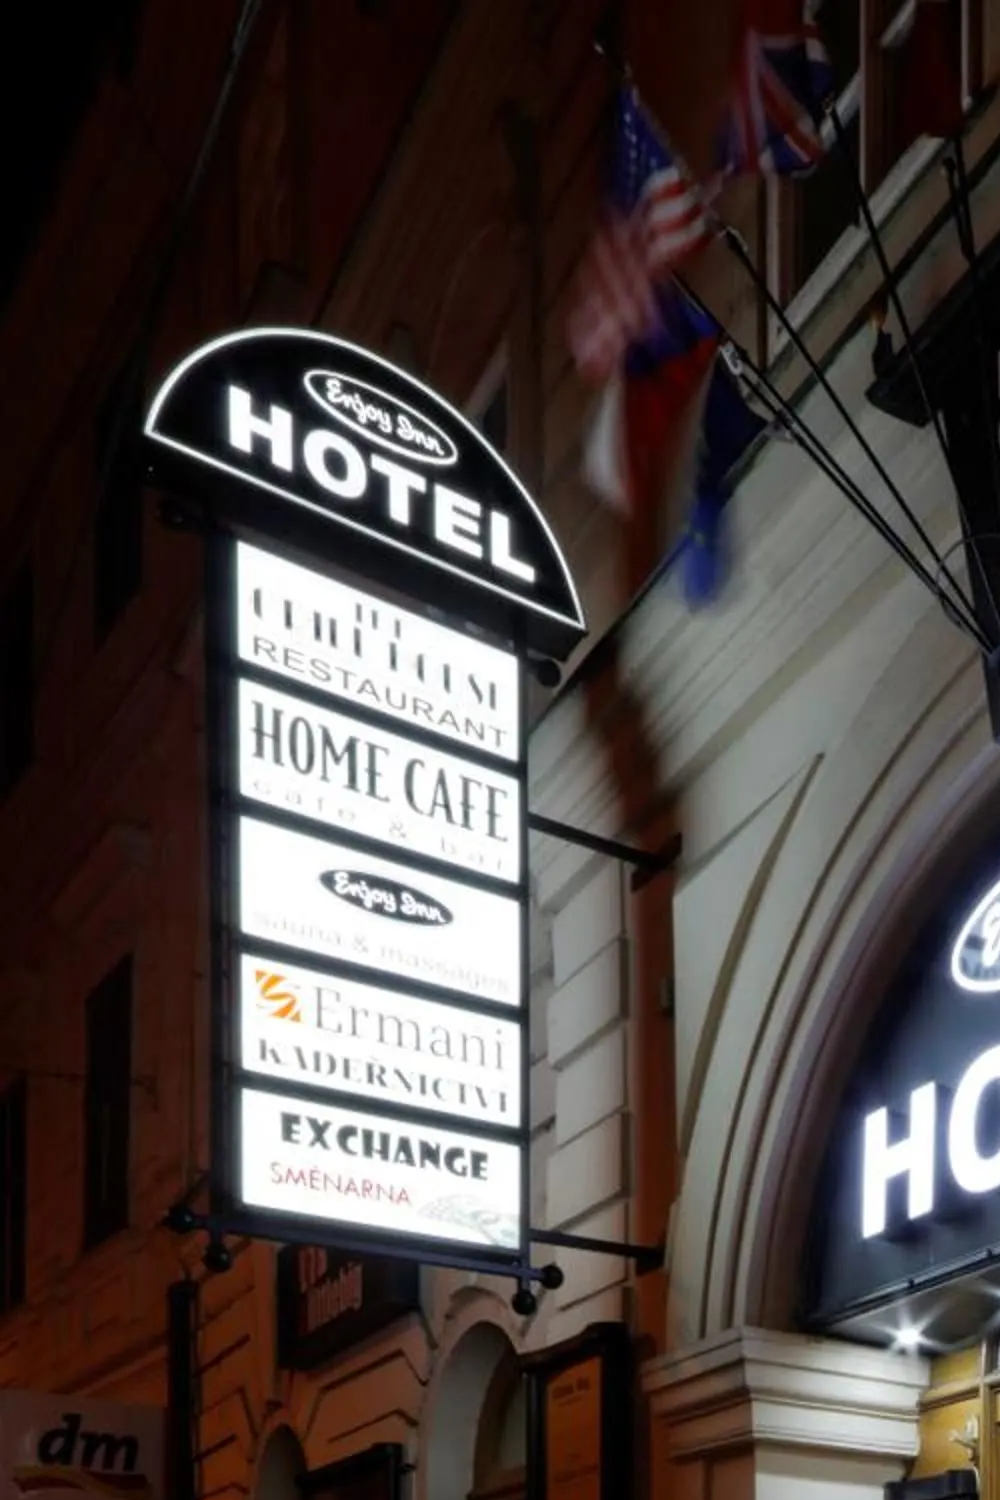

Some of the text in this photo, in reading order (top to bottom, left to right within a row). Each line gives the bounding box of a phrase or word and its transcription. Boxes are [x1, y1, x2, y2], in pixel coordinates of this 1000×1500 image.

[325, 378, 446, 456] Enjoy Inn
[228, 384, 536, 584] HOTEL
[253, 636, 508, 749] RESTAURANT
[249, 699, 510, 843] HOME CAFE
[333, 872, 447, 924] Enjoy Inn
[312, 984, 507, 1072] Ermani
[279, 1111, 490, 1182] EXCHANGE
[38, 1412, 140, 1472] dm
